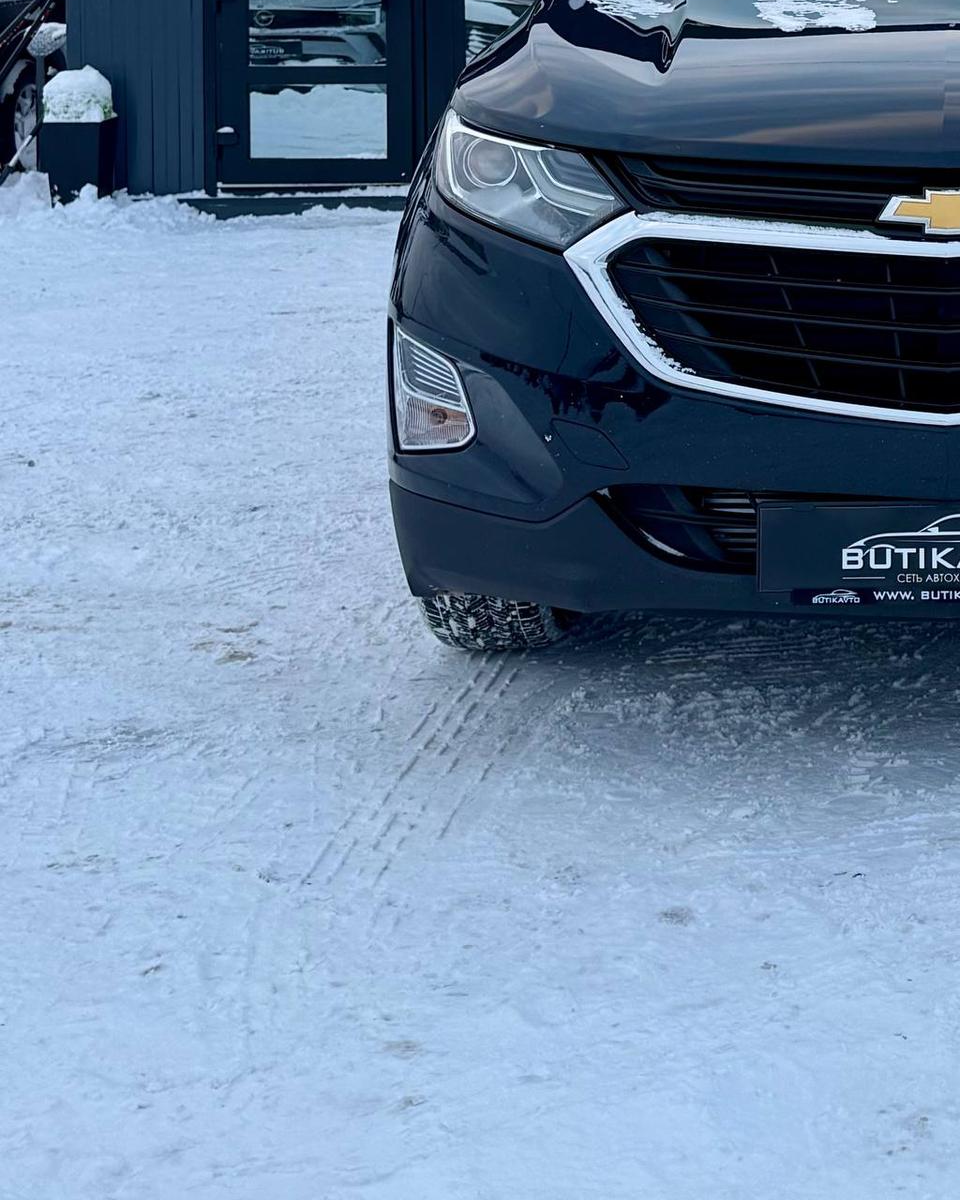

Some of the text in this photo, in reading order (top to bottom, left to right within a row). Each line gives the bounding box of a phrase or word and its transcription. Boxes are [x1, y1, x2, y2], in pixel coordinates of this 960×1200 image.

[896, 573, 923, 583] СЕТЬ
[812, 596, 860, 604] BUTIKAVTO
[873, 591, 915, 601] WWW.
